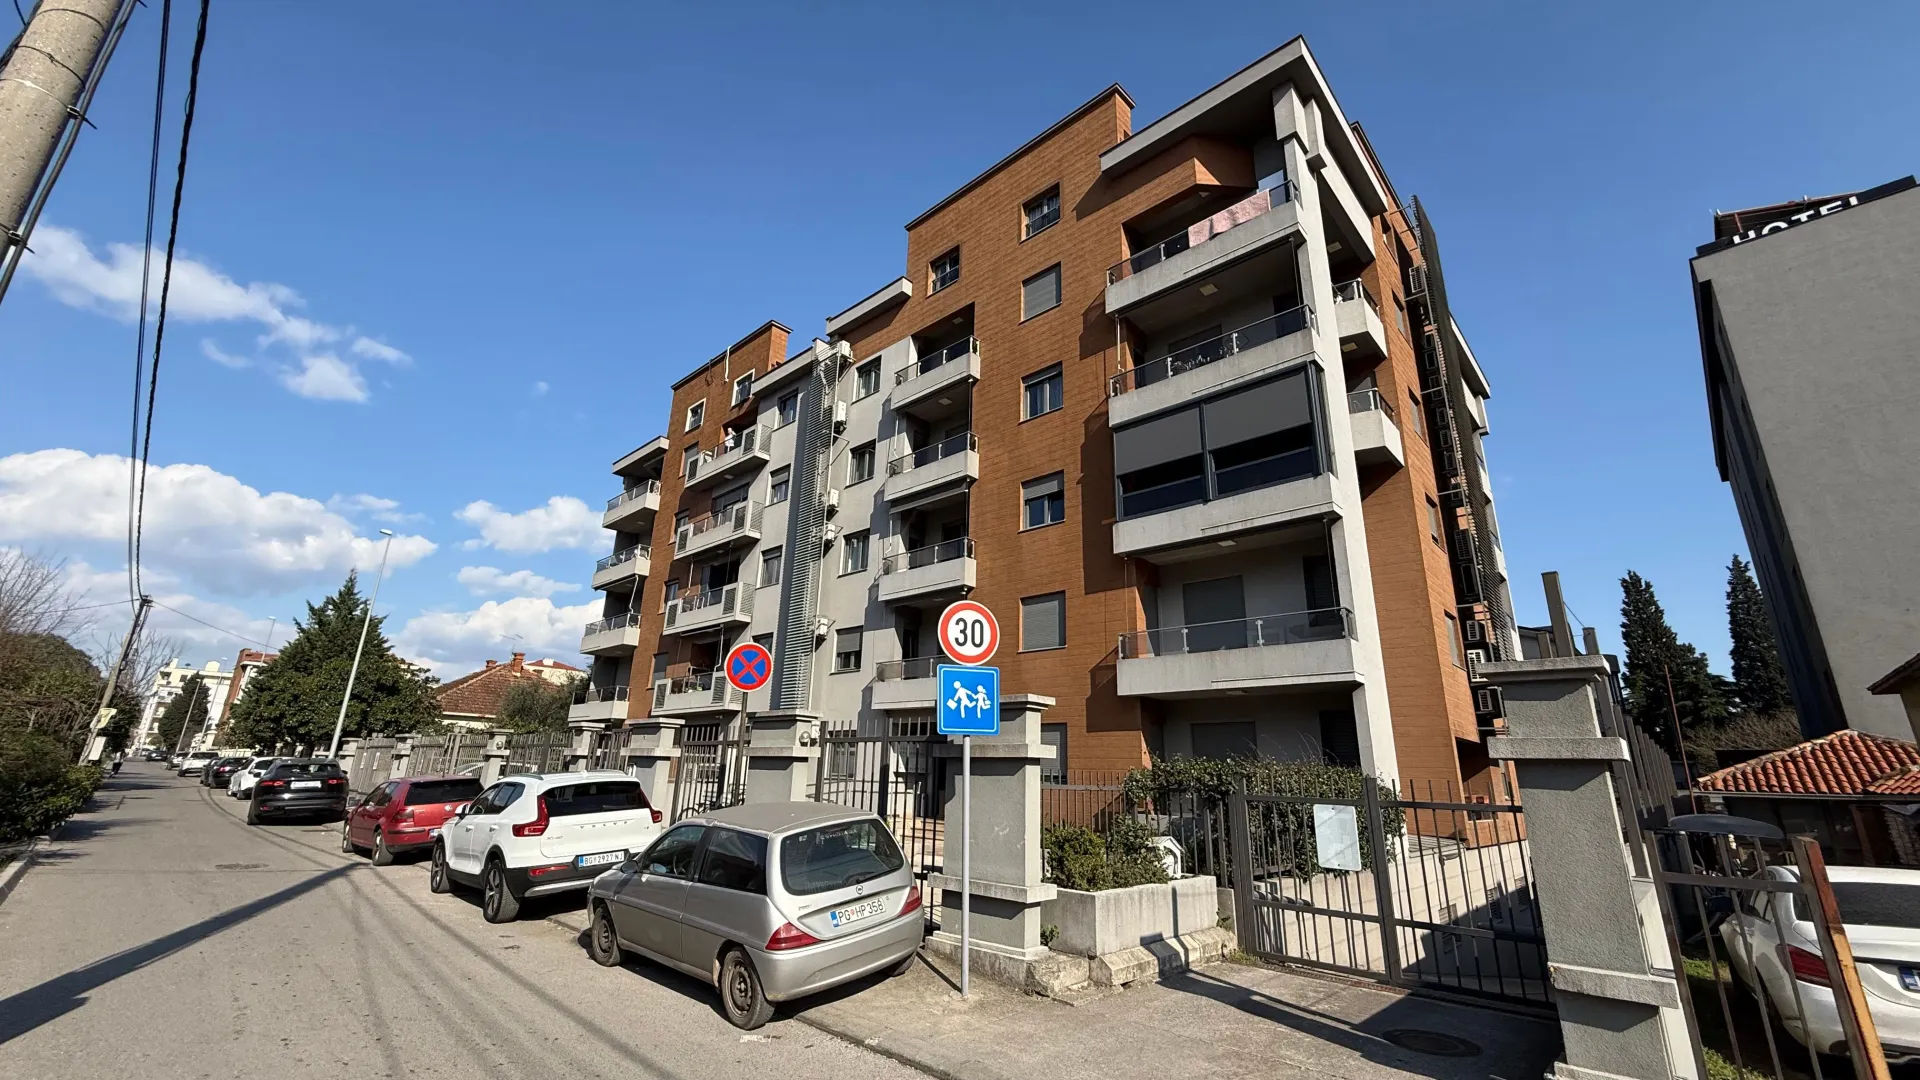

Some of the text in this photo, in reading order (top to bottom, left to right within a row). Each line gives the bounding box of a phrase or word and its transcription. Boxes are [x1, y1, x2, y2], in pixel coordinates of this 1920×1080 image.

[954, 617, 984, 648] 30
[584, 856, 593, 865] BG
[838, 909, 851, 923] PG
